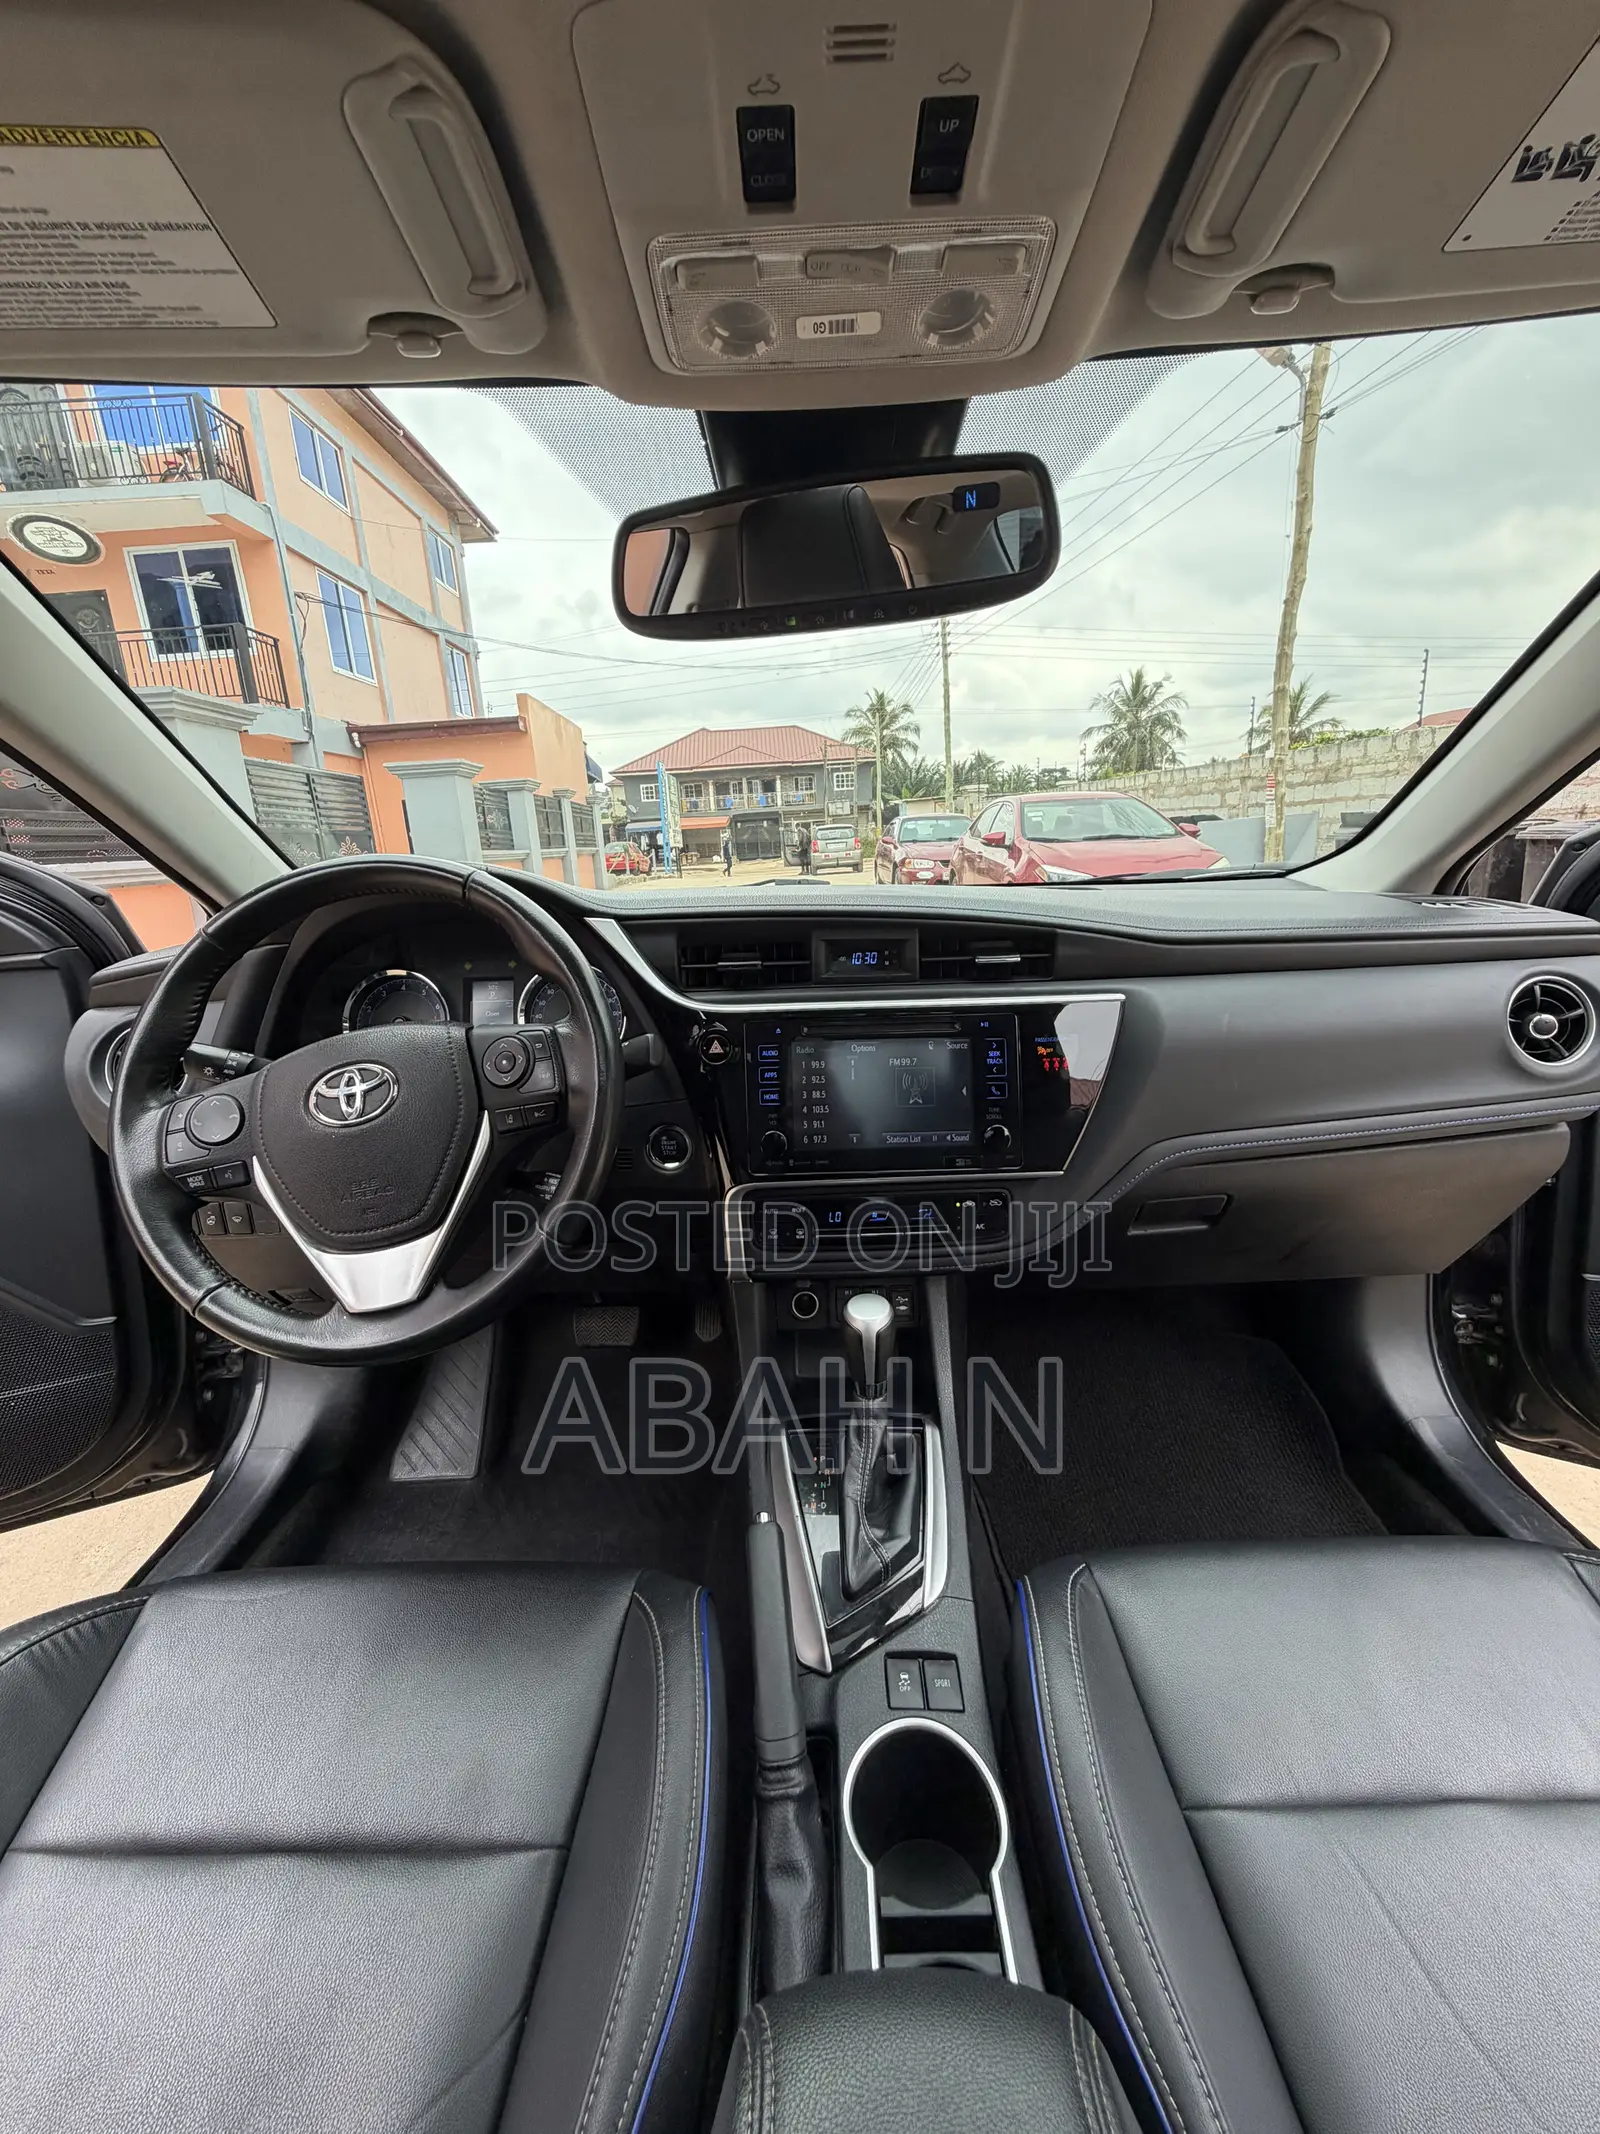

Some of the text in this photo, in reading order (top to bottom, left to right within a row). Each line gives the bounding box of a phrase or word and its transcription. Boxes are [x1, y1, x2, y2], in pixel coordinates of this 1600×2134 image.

[939, 118, 961, 133] UP
[0, 127, 151, 147] ADVERTENCIA
[747, 127, 785, 143] OPEN
[965, 490, 977, 509] N
[851, 951, 878, 965] 10:30
[796, 1046, 815, 1054] Radio
[851, 1043, 876, 1053] Options
[946, 1041, 968, 1050] Source
[811, 1060, 826, 1069] 99.9
[801, 1075, 826, 1084] 2 92.5
[802, 1090, 826, 1099] 3 88.5
[802, 1105, 830, 1114] 4 103.5
[803, 1120, 825, 1129] 5 91.1
[803, 1134, 828, 1144] 6 97.3
[886, 1134, 921, 1144] Station List
[951, 1133, 970, 1142] Sound
[828, 1211, 842, 1223] LO
[820, 1480, 827, 1489] N
[934, 1678, 951, 1688] SPORT
